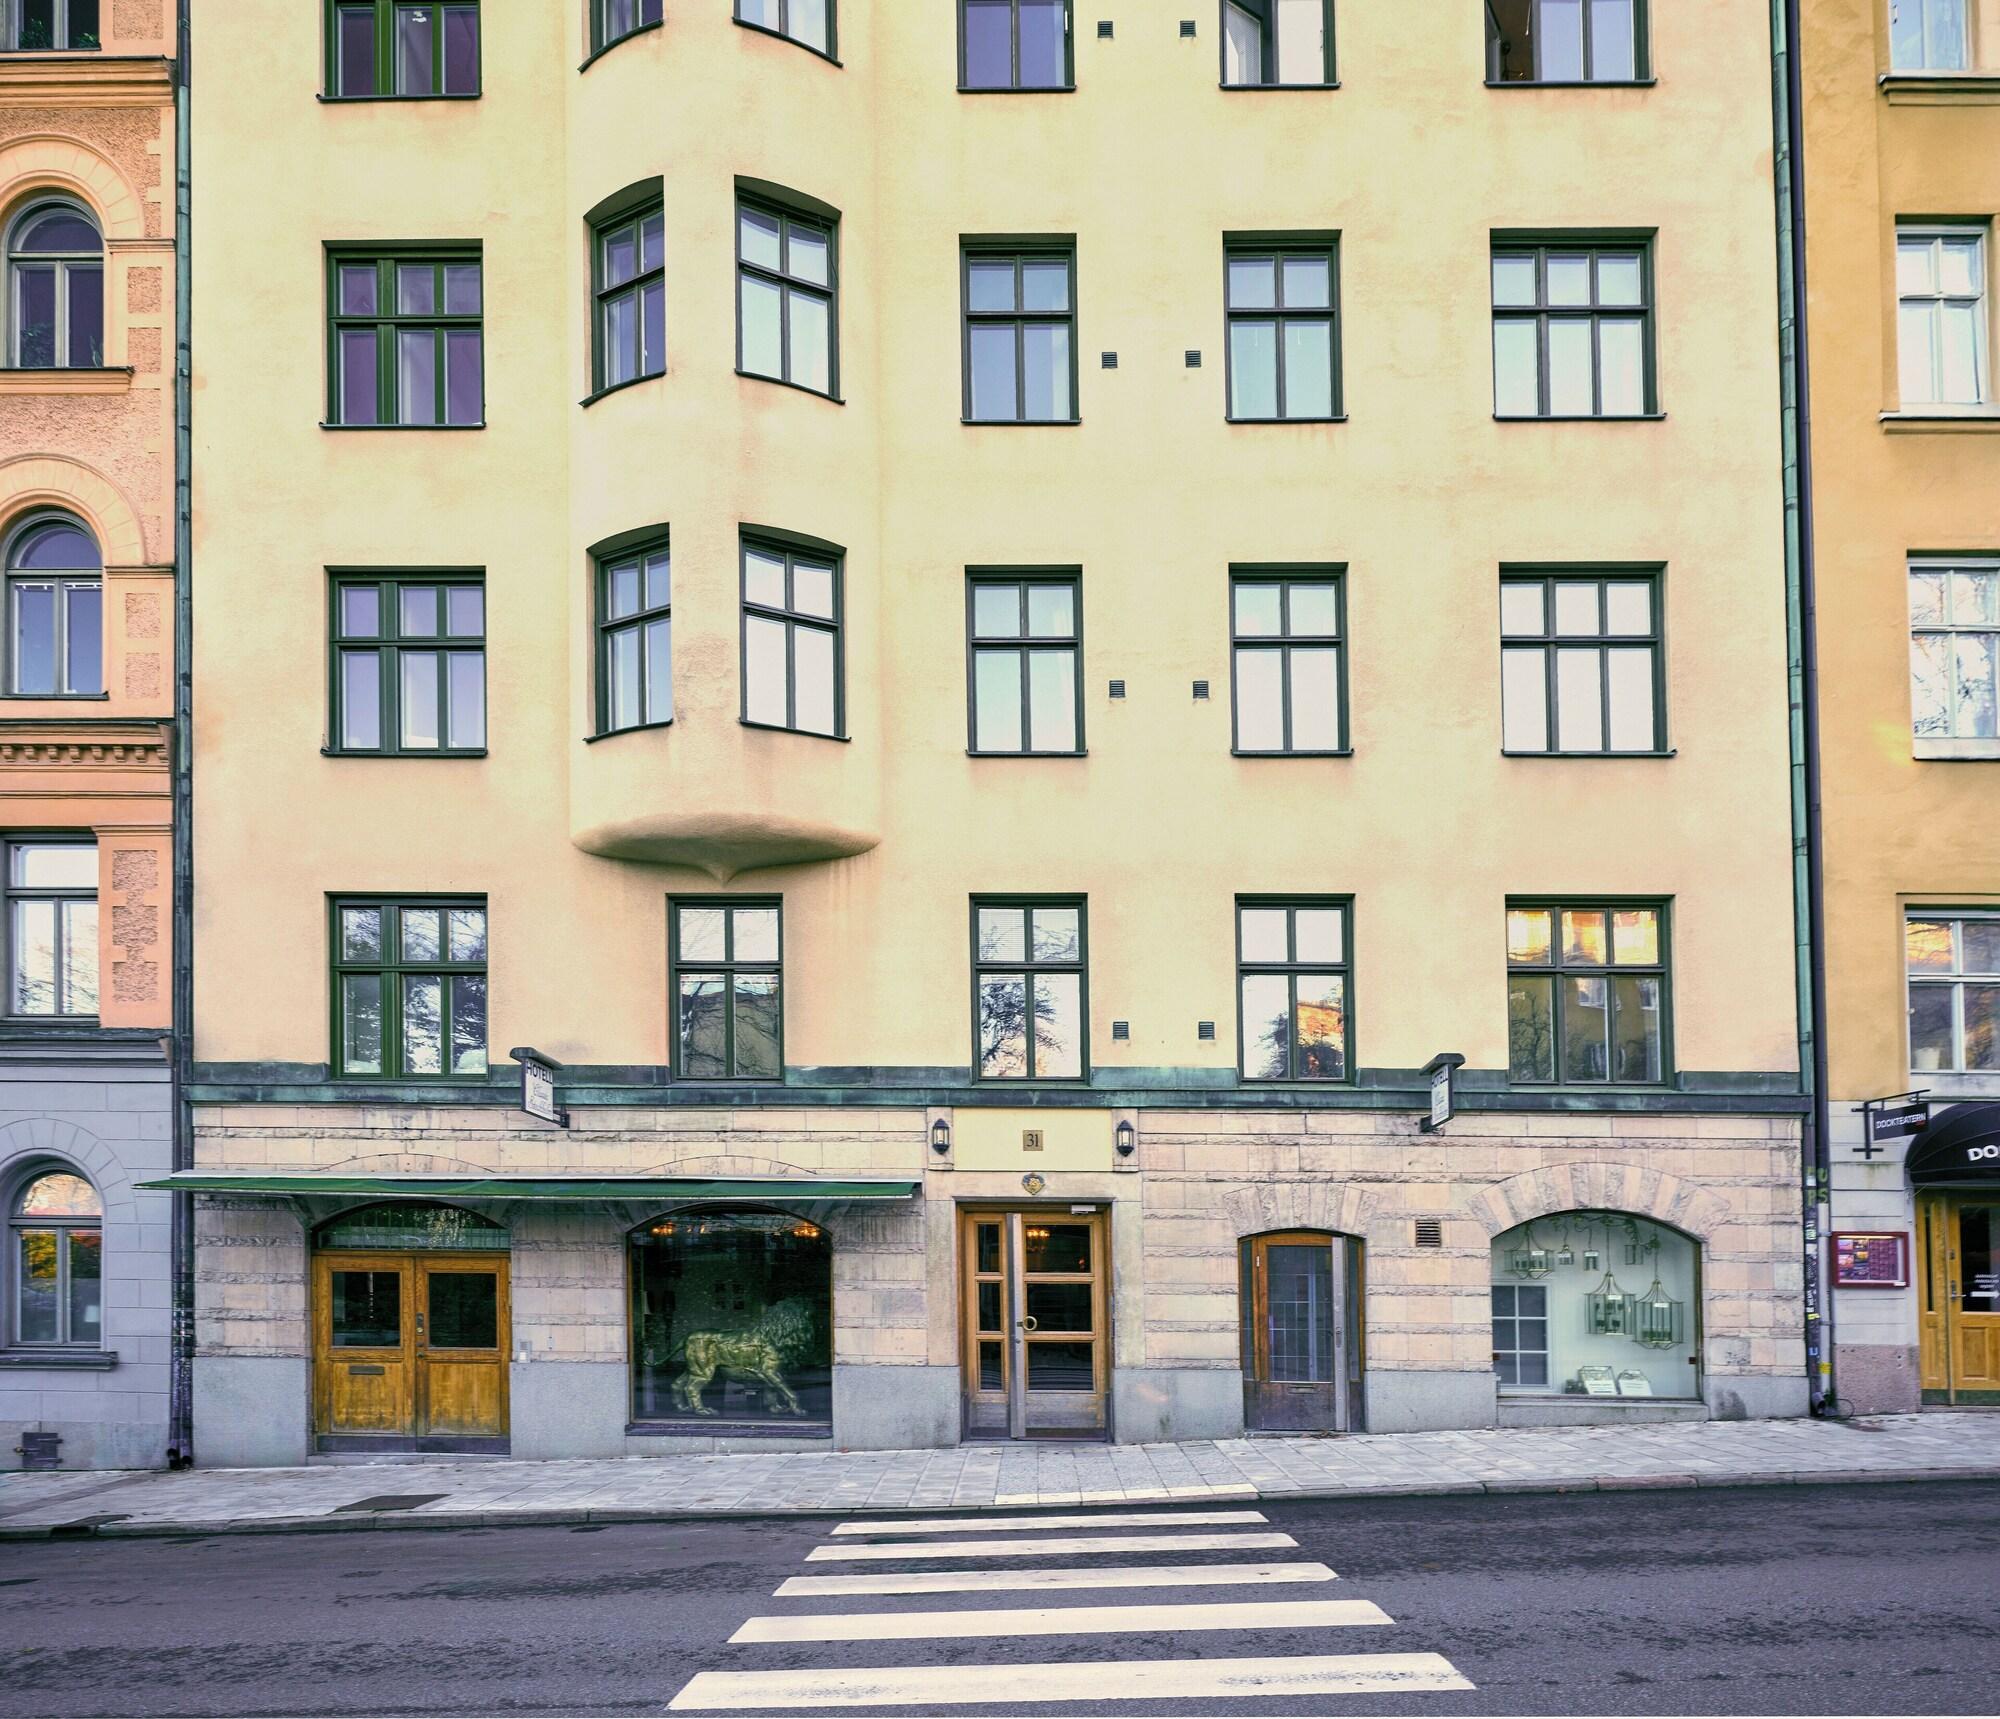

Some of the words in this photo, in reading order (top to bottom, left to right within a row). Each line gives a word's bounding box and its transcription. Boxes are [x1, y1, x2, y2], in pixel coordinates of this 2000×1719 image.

[526, 1060, 553, 1085] HOTELL
[1875, 1112, 1927, 1129] DOCKTEATERN
[1026, 1133, 1039, 1147] 31
[1967, 1144, 2000, 1161] DO
